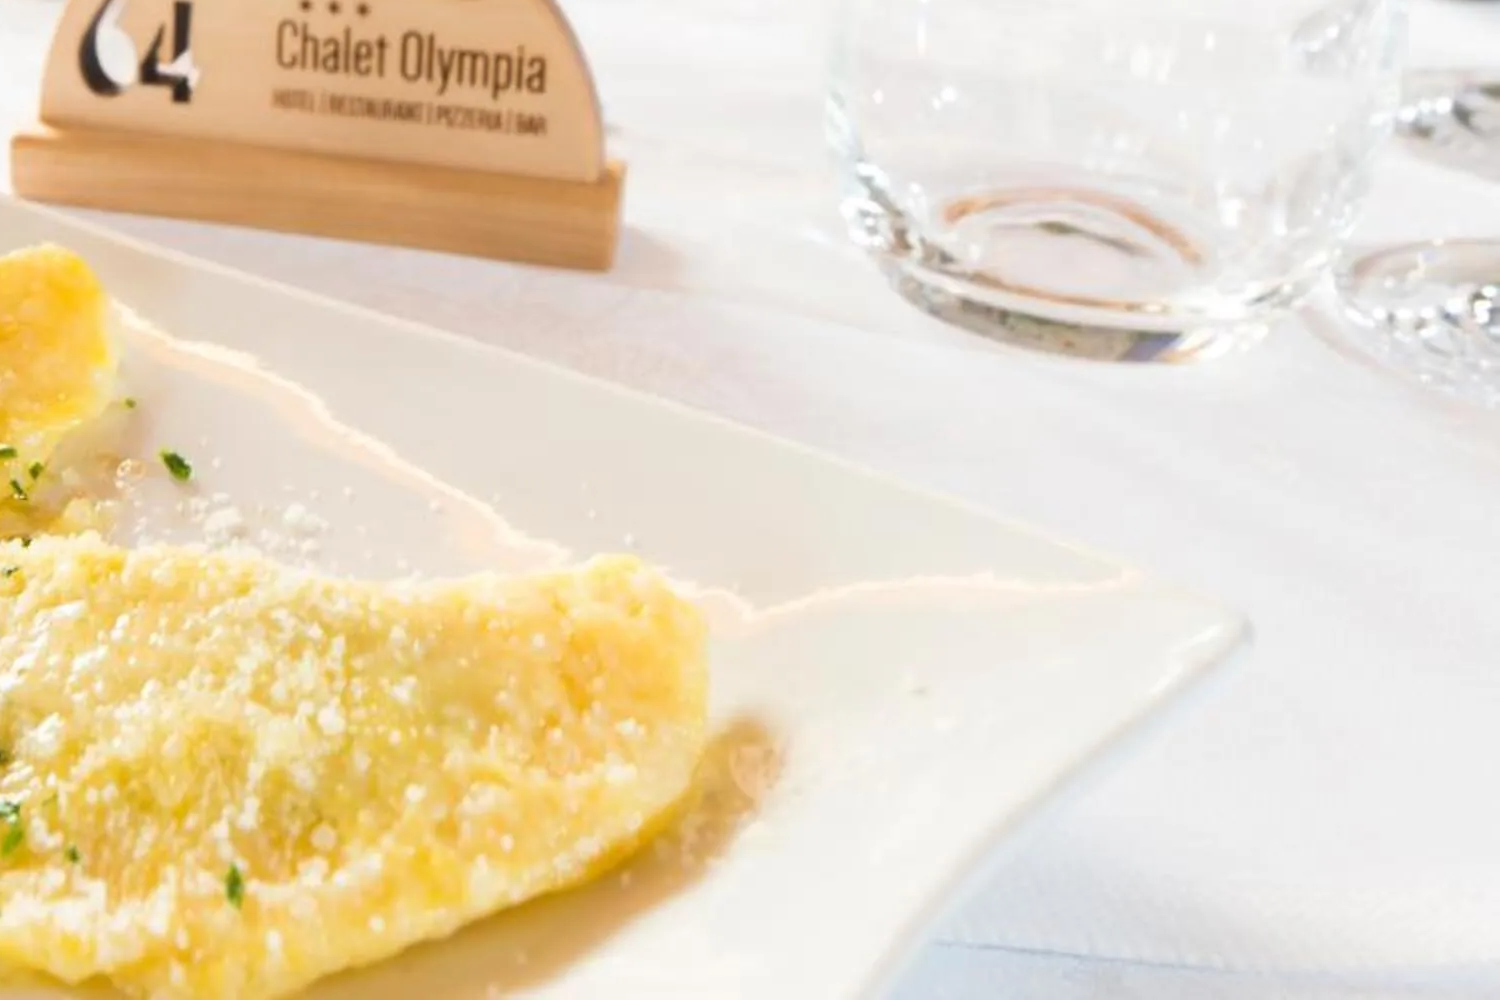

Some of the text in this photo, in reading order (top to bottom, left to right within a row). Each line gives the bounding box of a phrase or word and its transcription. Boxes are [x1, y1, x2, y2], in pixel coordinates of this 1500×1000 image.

[276, 18, 547, 100] Chalet Olympia
[330, 93, 424, 123] RESTAURANT
[436, 104, 504, 130] PIZZERIA
[516, 112, 548, 136] BAR
